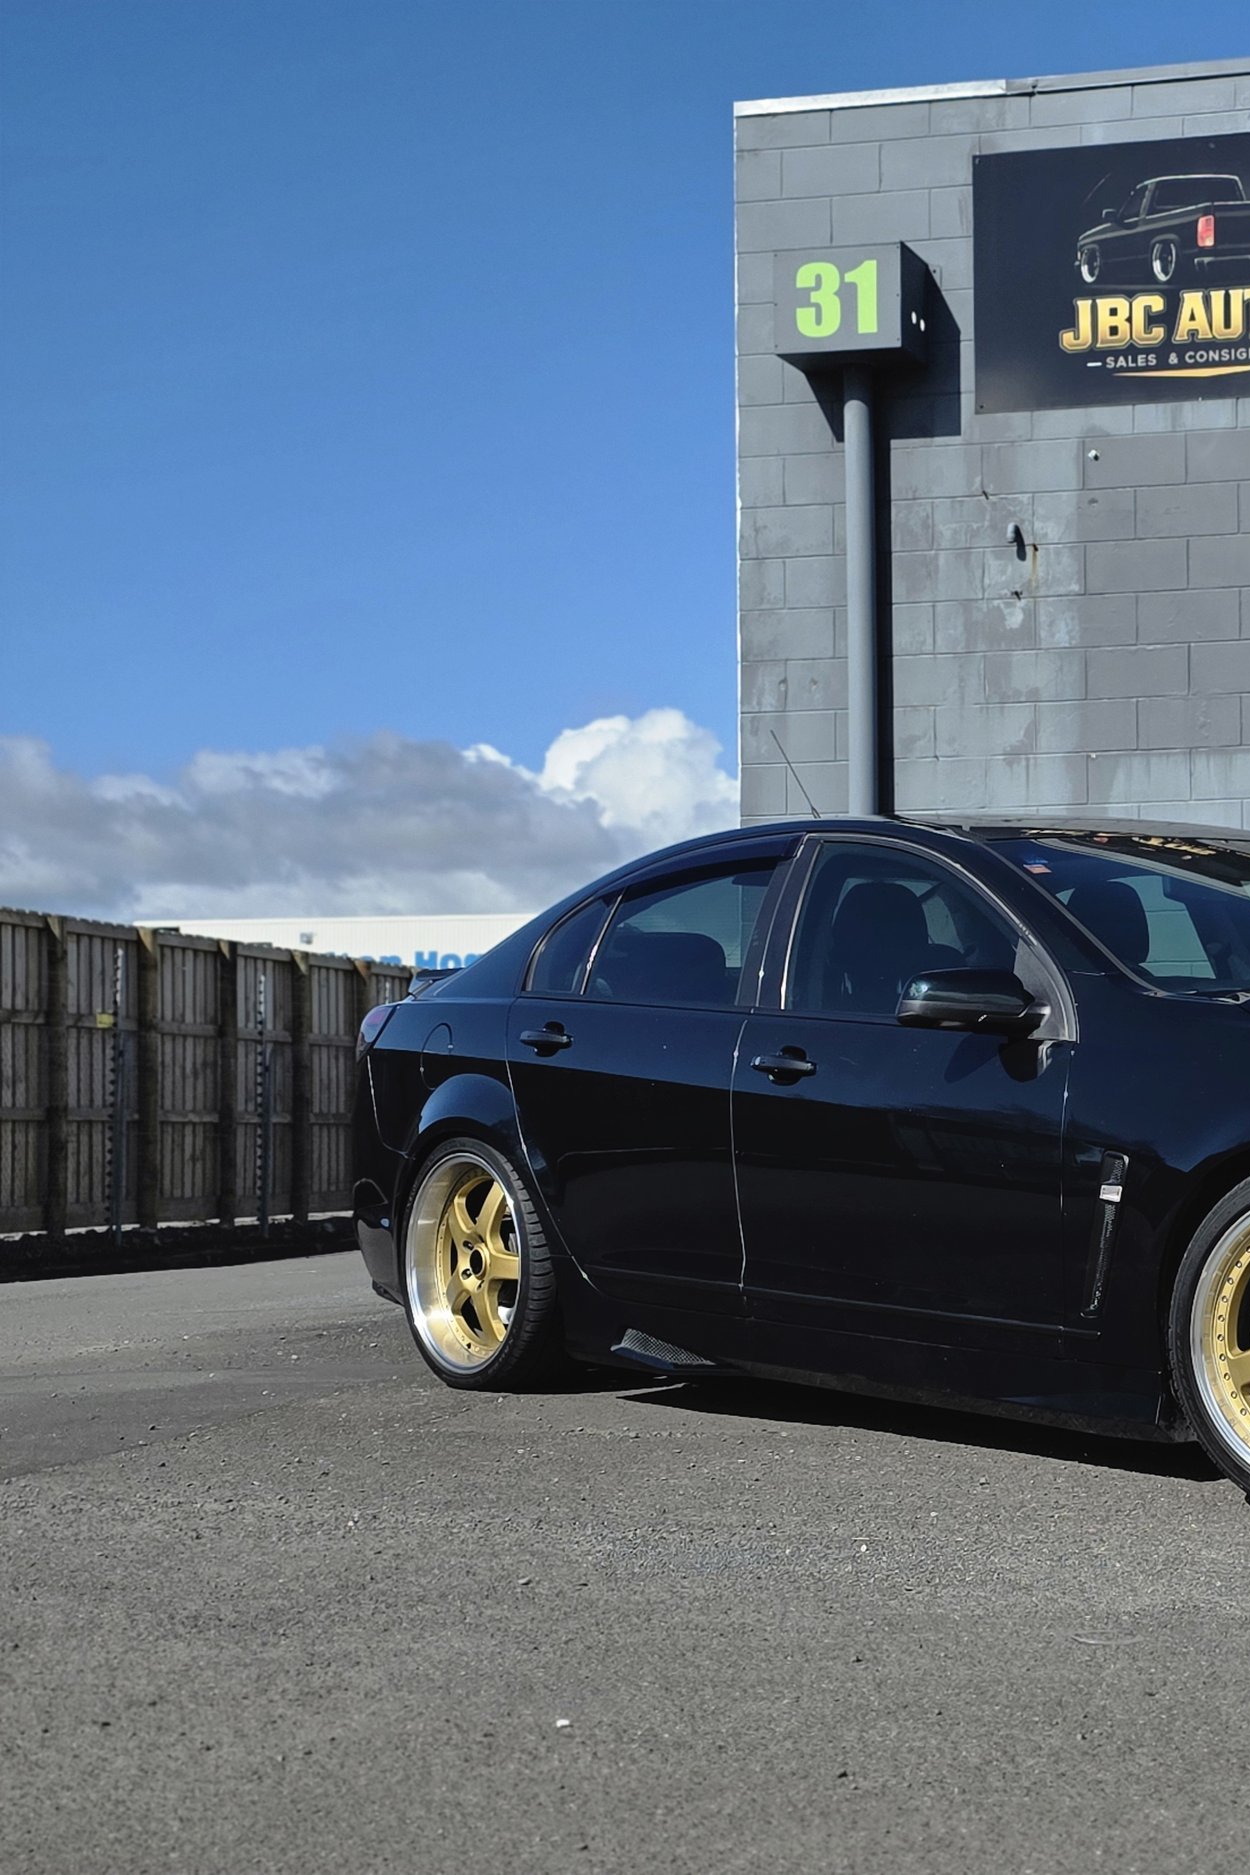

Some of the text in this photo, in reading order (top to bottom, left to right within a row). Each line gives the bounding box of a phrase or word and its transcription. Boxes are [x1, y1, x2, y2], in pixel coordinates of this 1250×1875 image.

[795, 259, 878, 338] 31
[1060, 294, 1166, 352] JBC
[1105, 354, 1157, 369] SALES
[1168, 352, 1179, 365] &
